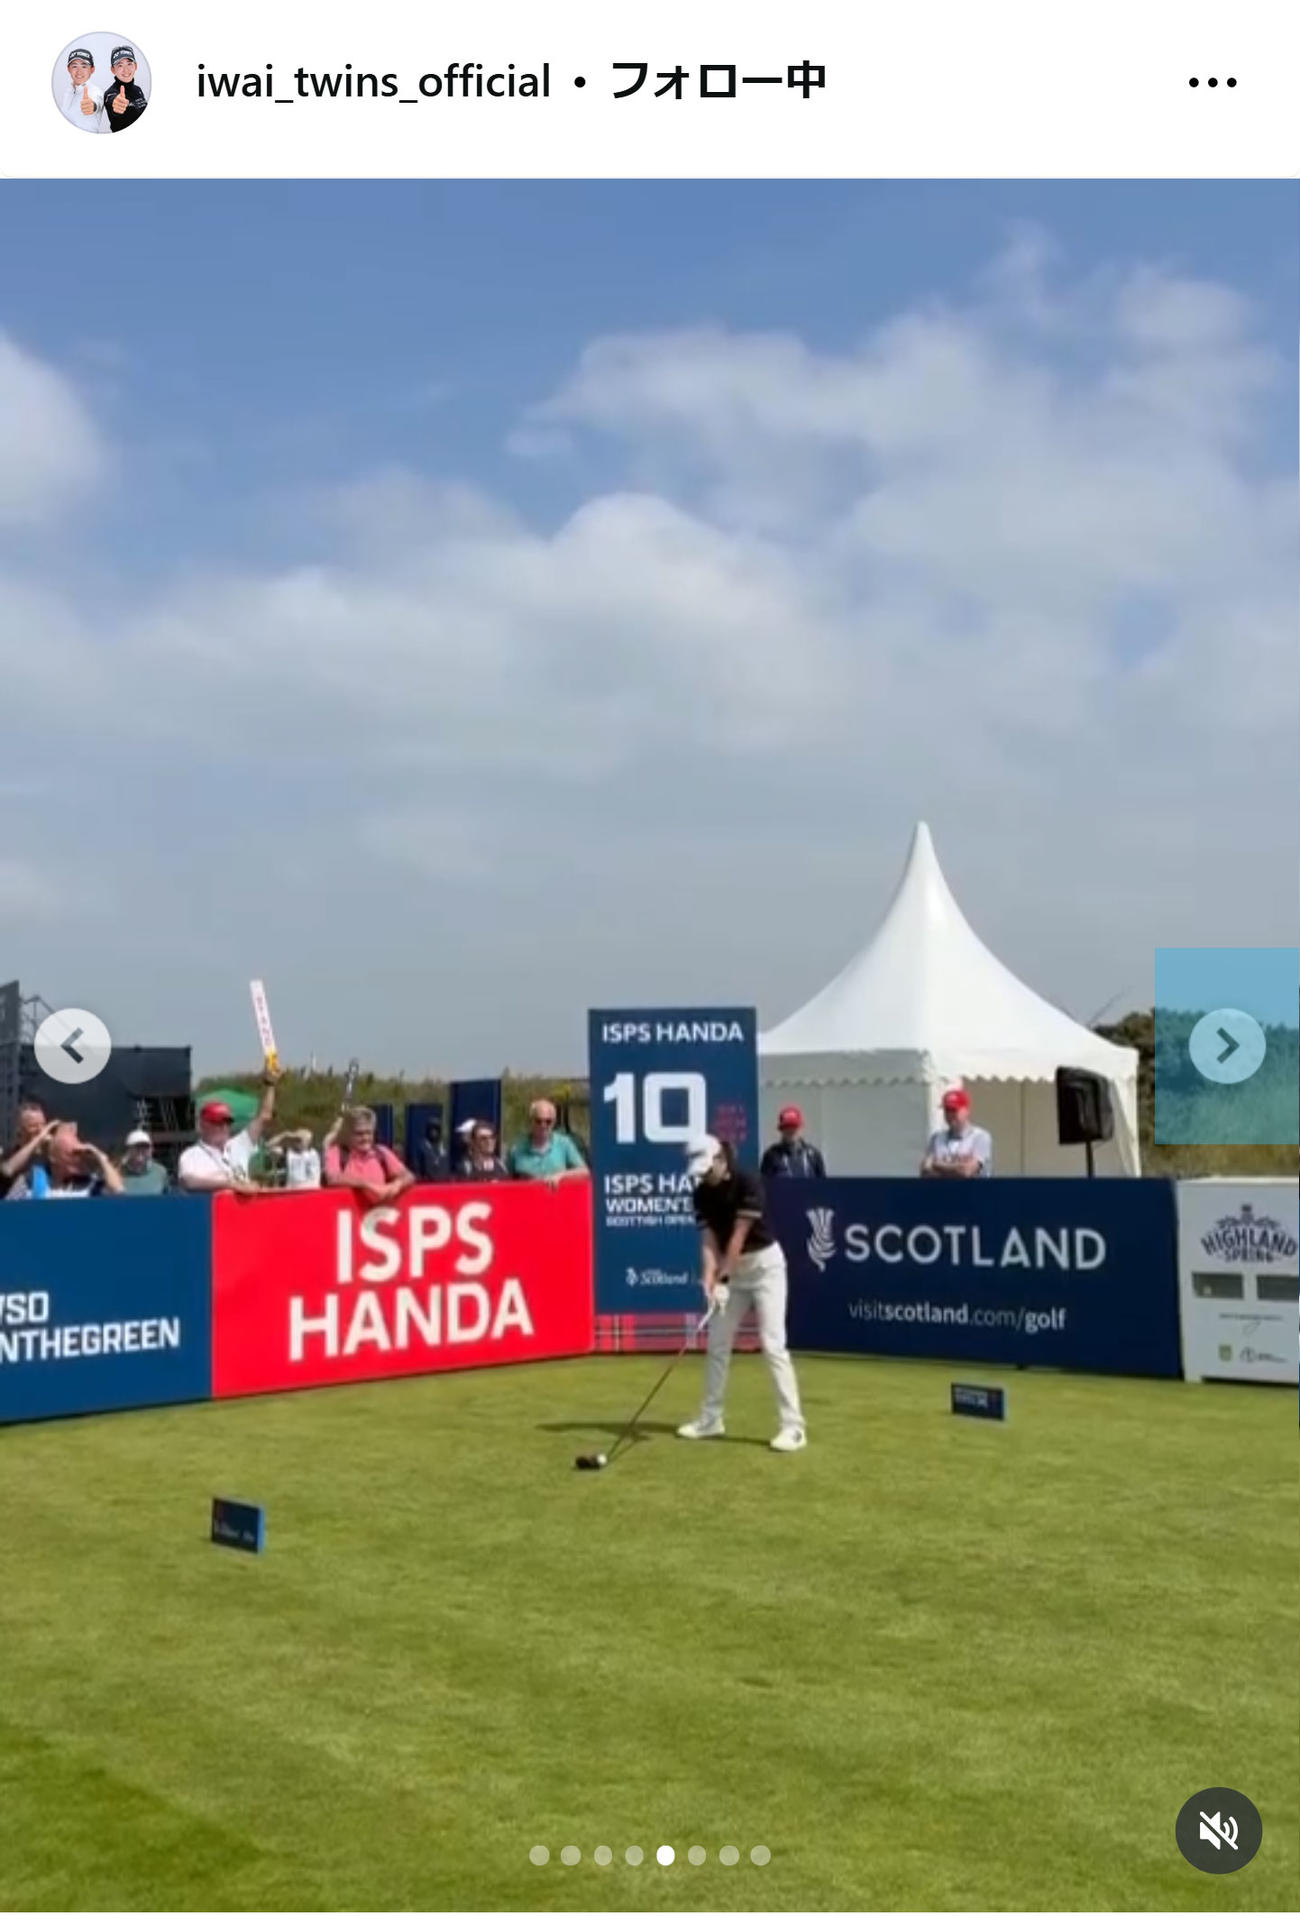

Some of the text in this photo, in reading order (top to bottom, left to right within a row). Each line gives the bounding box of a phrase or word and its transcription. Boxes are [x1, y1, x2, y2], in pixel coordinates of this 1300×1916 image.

[602, 1021, 744, 1043] ISPS HANDA
[603, 1072, 708, 1144] 10
[604, 1174, 653, 1195] ISPS
[337, 1201, 494, 1284] ISPS
[844, 1223, 1107, 1271] SCOTLAND
[1200, 1227, 1297, 1257] HIGHLAND
[288, 1278, 535, 1362] HANDA
[848, 1299, 1068, 1335] visitscotland.com/golf
